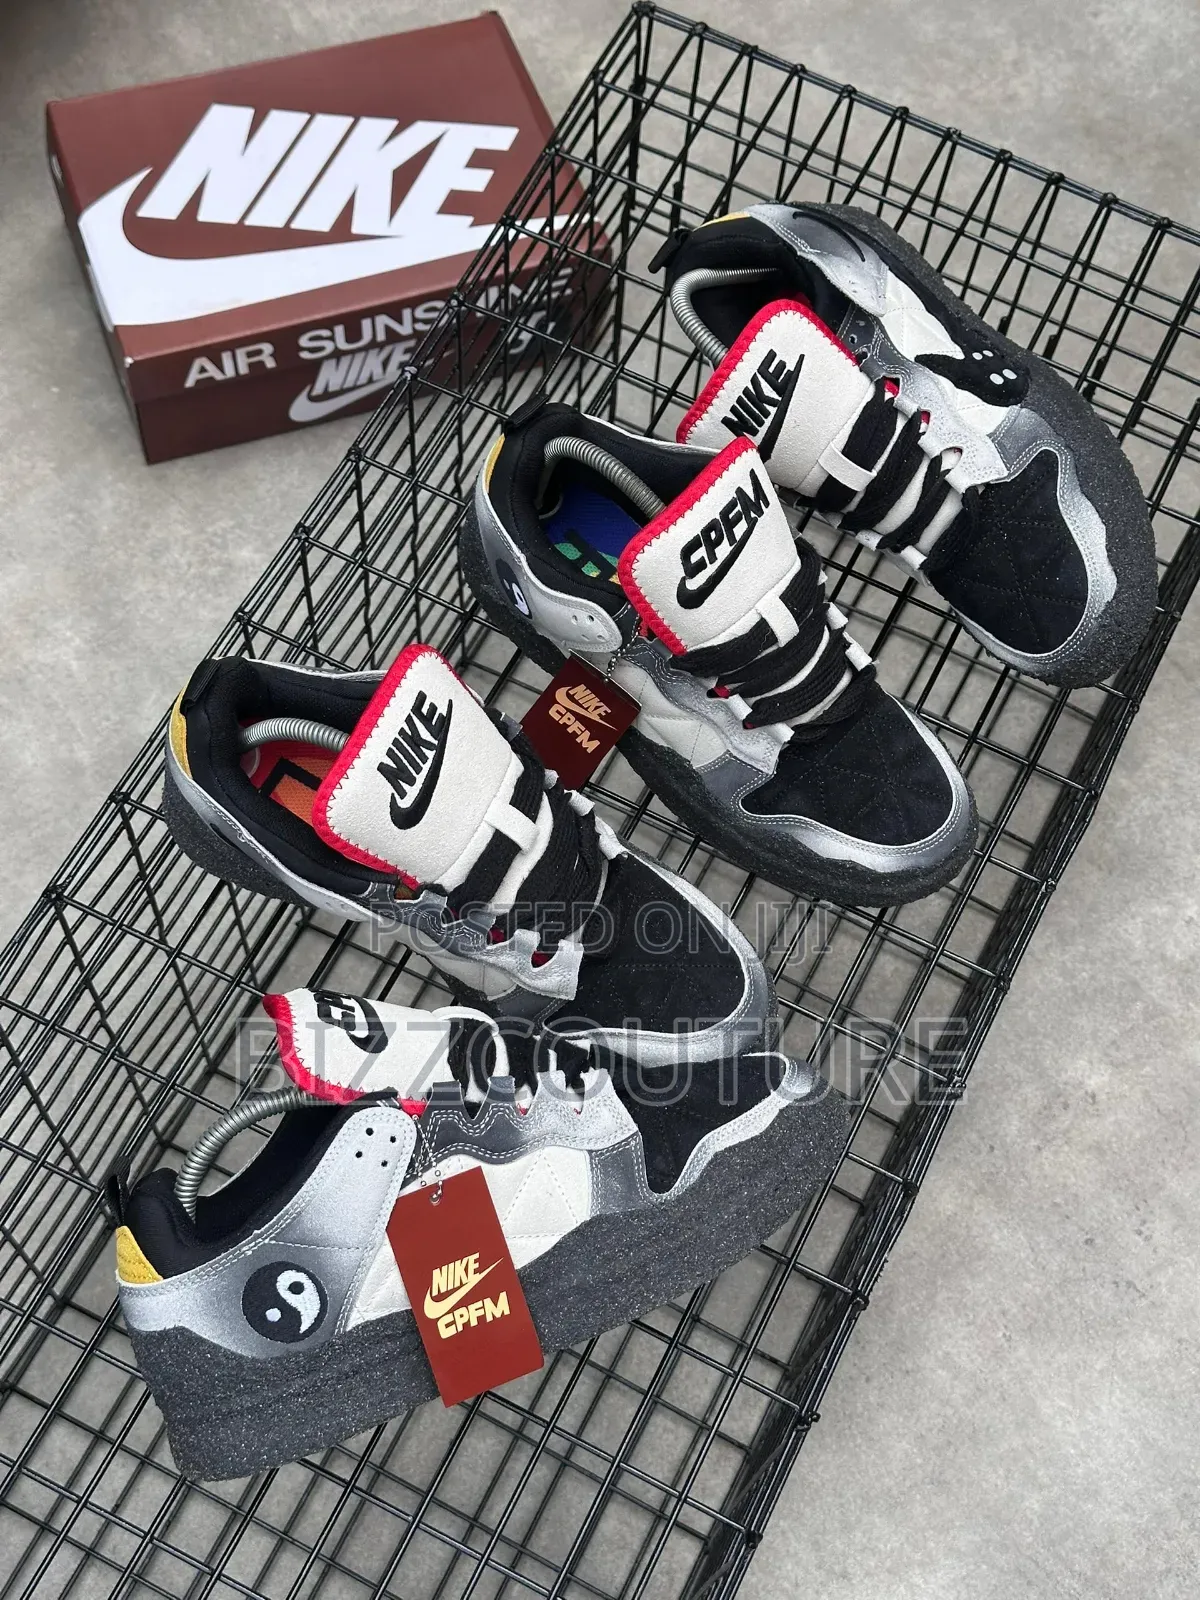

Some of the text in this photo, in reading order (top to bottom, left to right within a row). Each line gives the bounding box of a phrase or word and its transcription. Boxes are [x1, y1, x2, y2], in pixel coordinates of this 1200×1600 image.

[136, 102, 520, 237] NIKE
[184, 342, 277, 389] AIR
[311, 338, 418, 396] NIKE
[721, 348, 794, 437] NIKE
[680, 468, 770, 579] CPFM
[548, 703, 601, 754] CPFM
[568, 684, 612, 719] NIKE
[377, 690, 447, 800] NIKE
[431, 1252, 480, 1297] NIKE
[437, 1291, 511, 1339] CPFM
